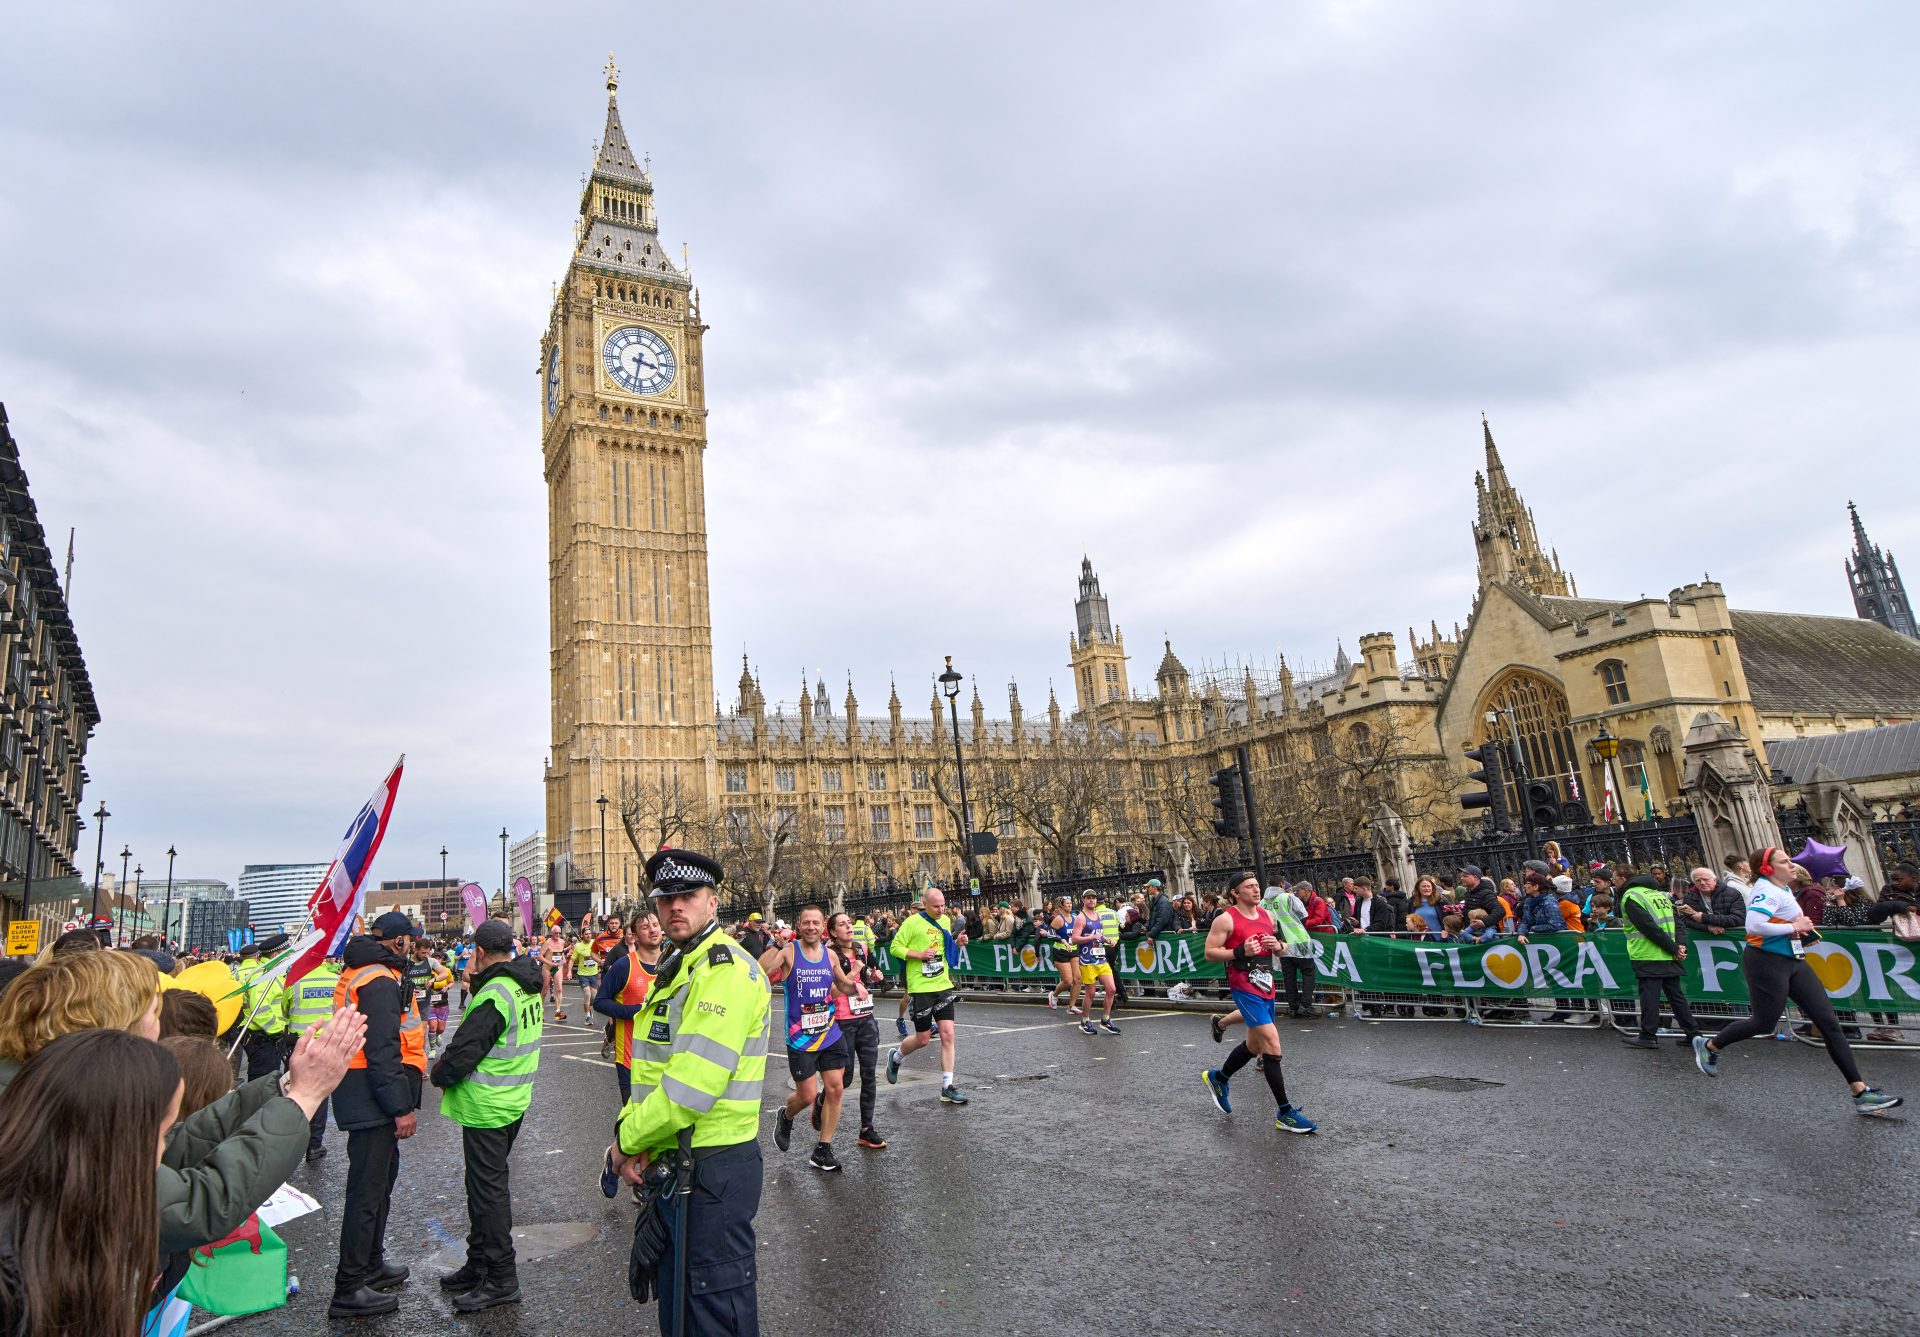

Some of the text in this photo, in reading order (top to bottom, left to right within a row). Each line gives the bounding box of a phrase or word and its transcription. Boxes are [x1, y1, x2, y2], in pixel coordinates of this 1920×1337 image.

[993, 944, 1058, 973] FLOR
[1119, 939, 1197, 974] LORA
[1415, 942, 1620, 990] FLORA
[796, 975, 822, 984] Cancer
[809, 988, 829, 998] MATT
[521, 1001, 541, 1030] 112
[698, 1001, 727, 1017] POLICE
